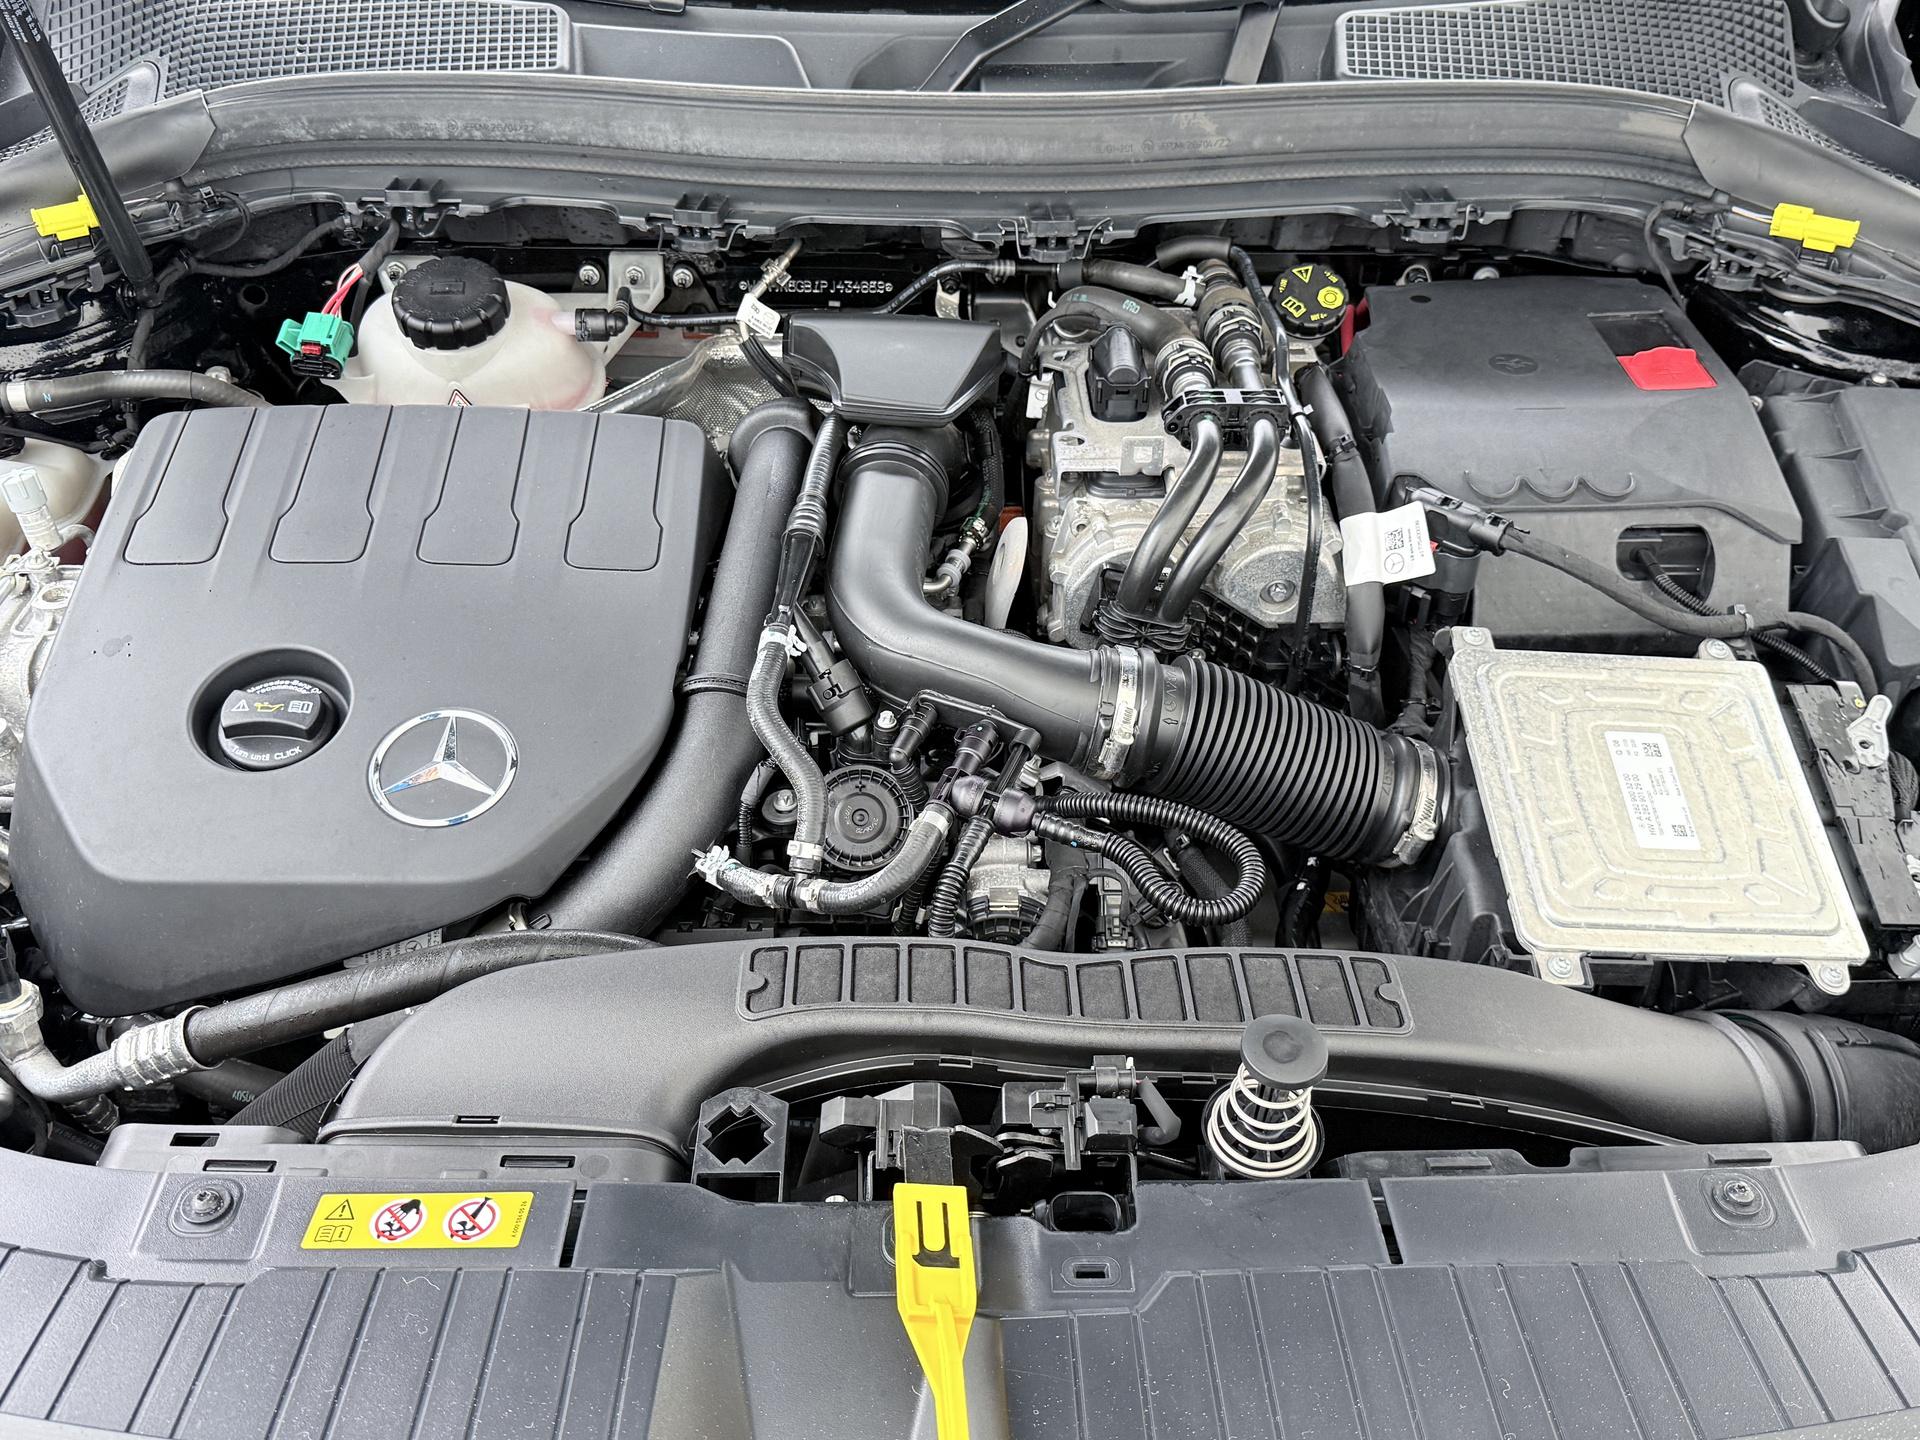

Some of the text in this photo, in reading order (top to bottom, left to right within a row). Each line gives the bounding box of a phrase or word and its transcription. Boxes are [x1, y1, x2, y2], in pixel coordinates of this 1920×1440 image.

[232, 746, 303, 762] Turn until CLICK
